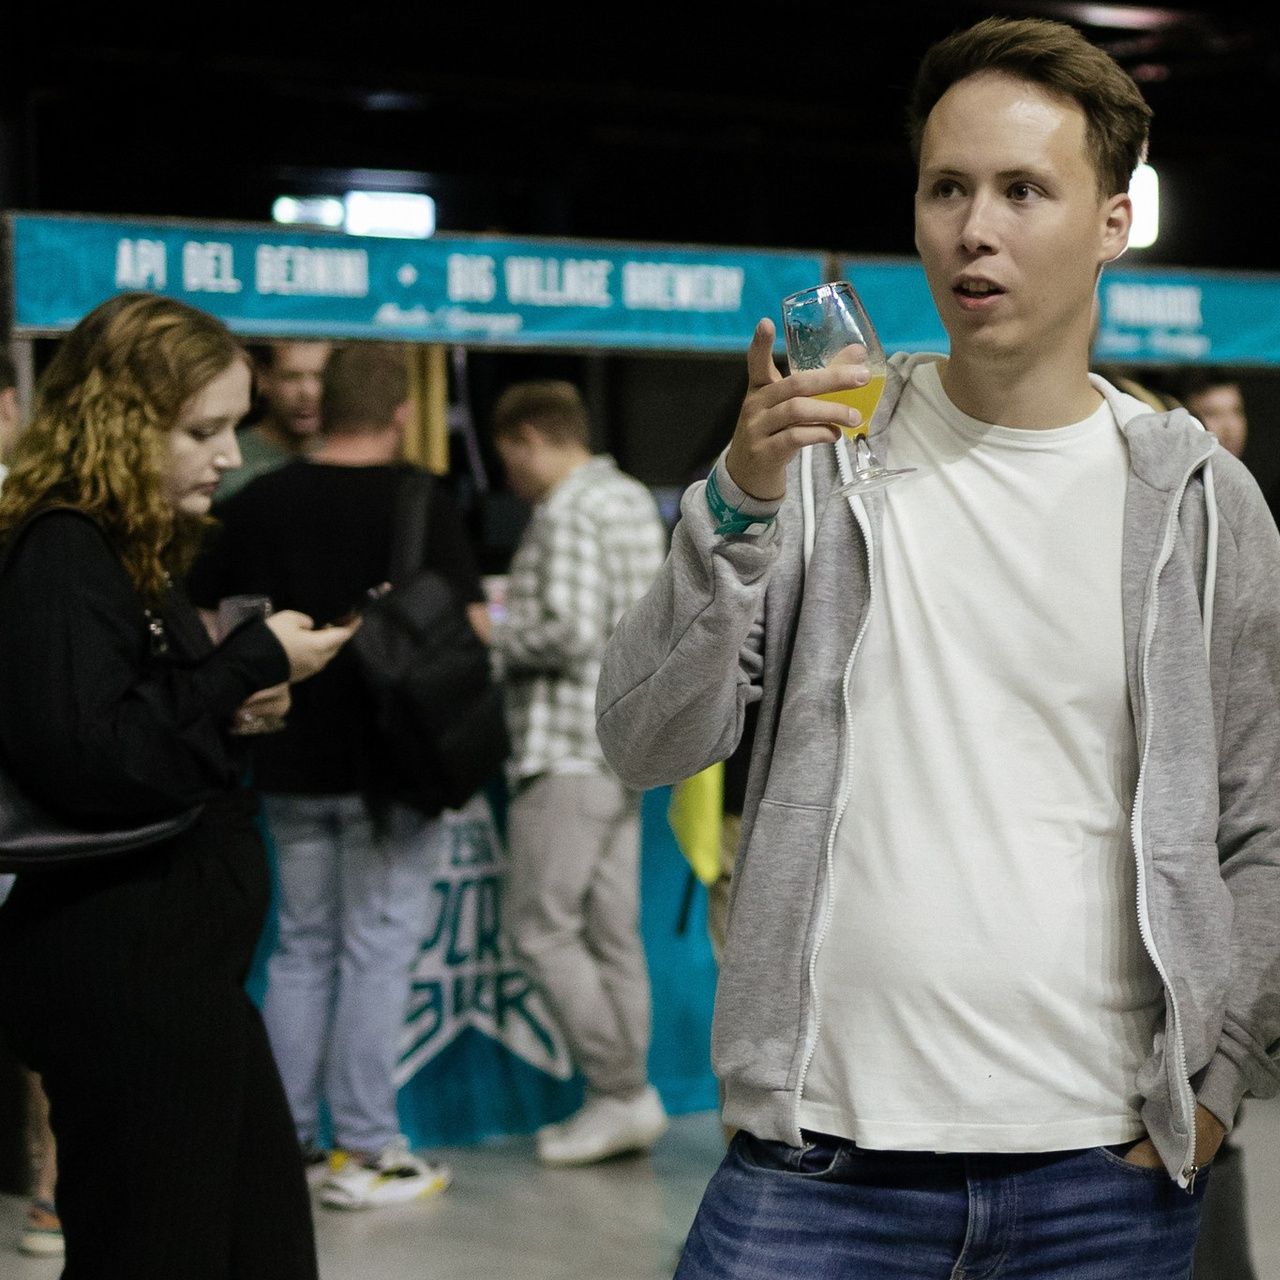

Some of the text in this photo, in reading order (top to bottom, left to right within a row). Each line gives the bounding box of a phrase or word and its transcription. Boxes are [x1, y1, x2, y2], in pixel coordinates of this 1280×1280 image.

[184, 243, 239, 292] DEL
[449, 255, 494, 300] BIG
[506, 258, 609, 306] VILLAGE
[624, 263, 742, 310] BREWERY
